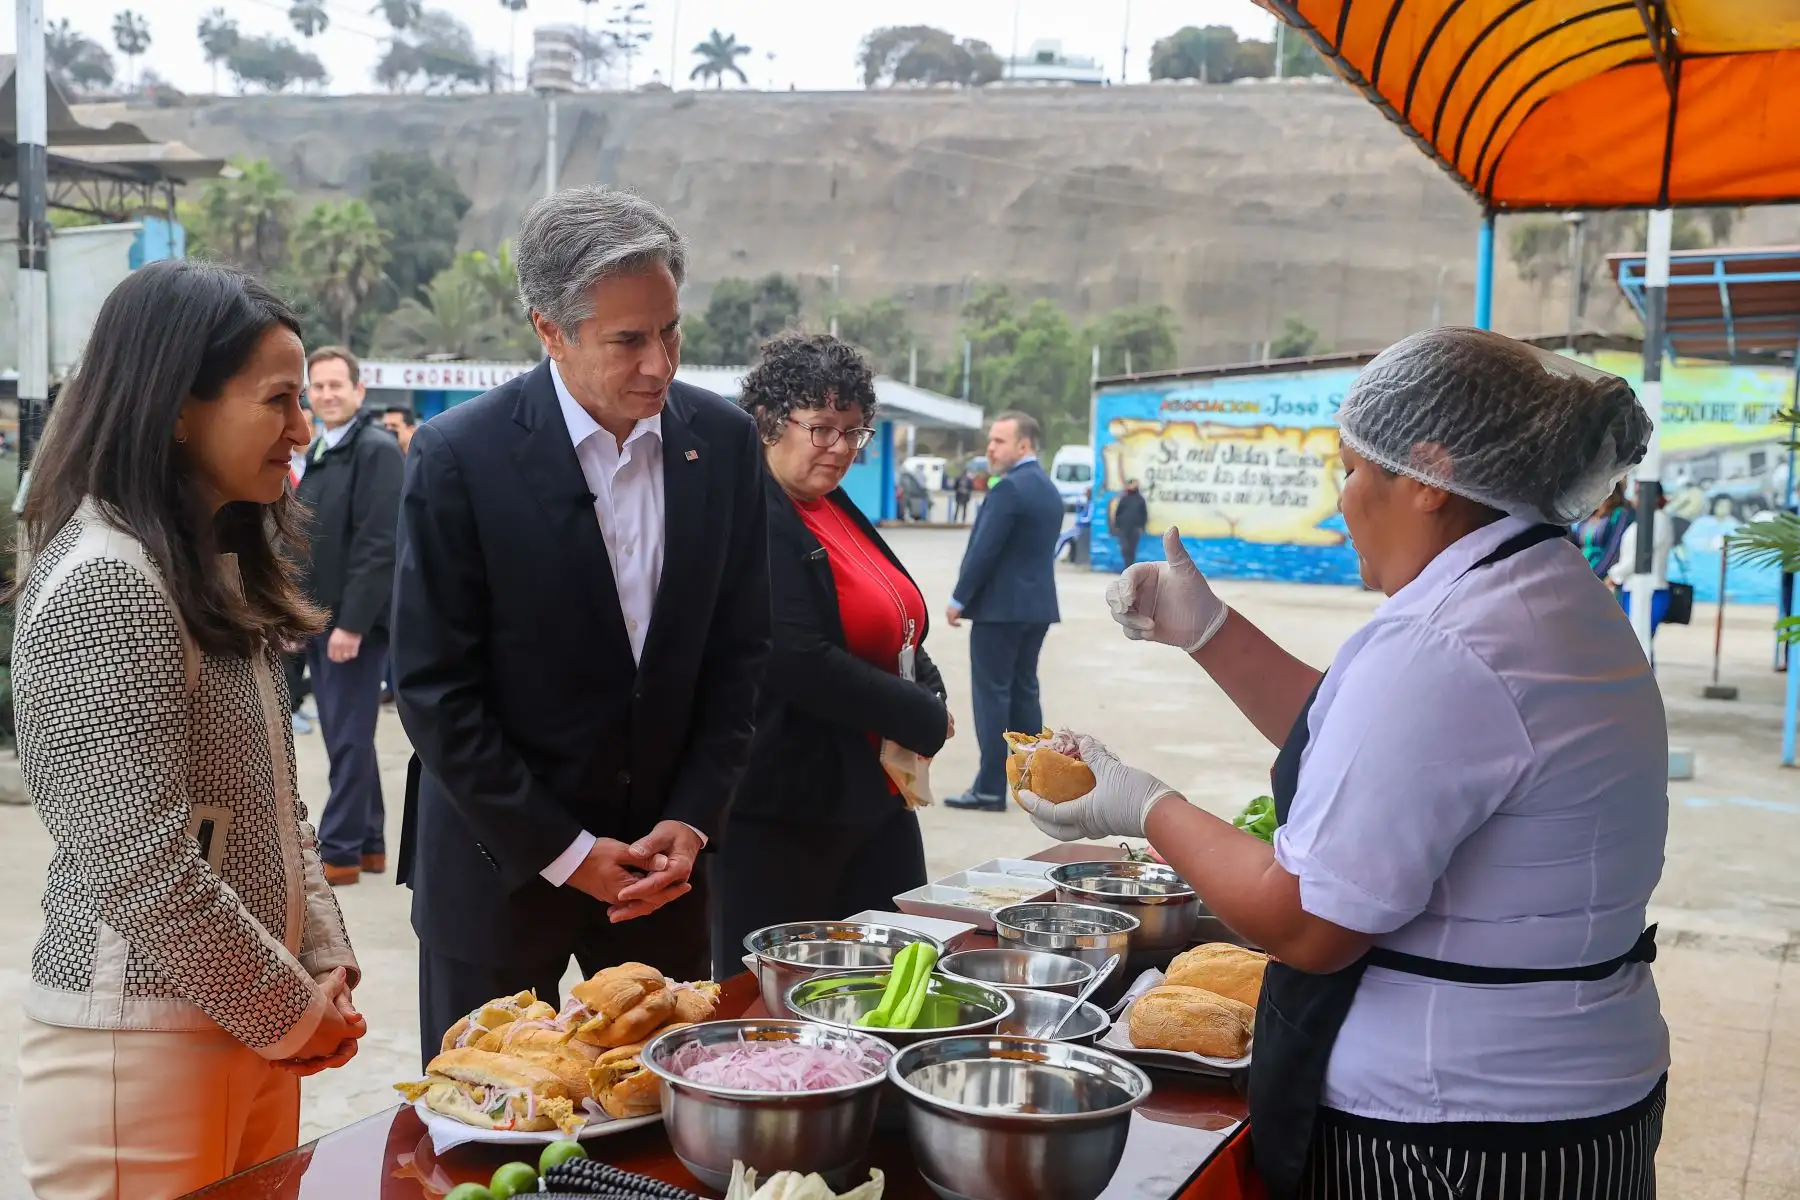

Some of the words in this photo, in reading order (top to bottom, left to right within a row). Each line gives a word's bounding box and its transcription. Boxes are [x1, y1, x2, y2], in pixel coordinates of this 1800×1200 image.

[403, 368, 524, 386] CHORRILLO
[1266, 393, 1319, 416] José
[1328, 393, 1345, 414] S
